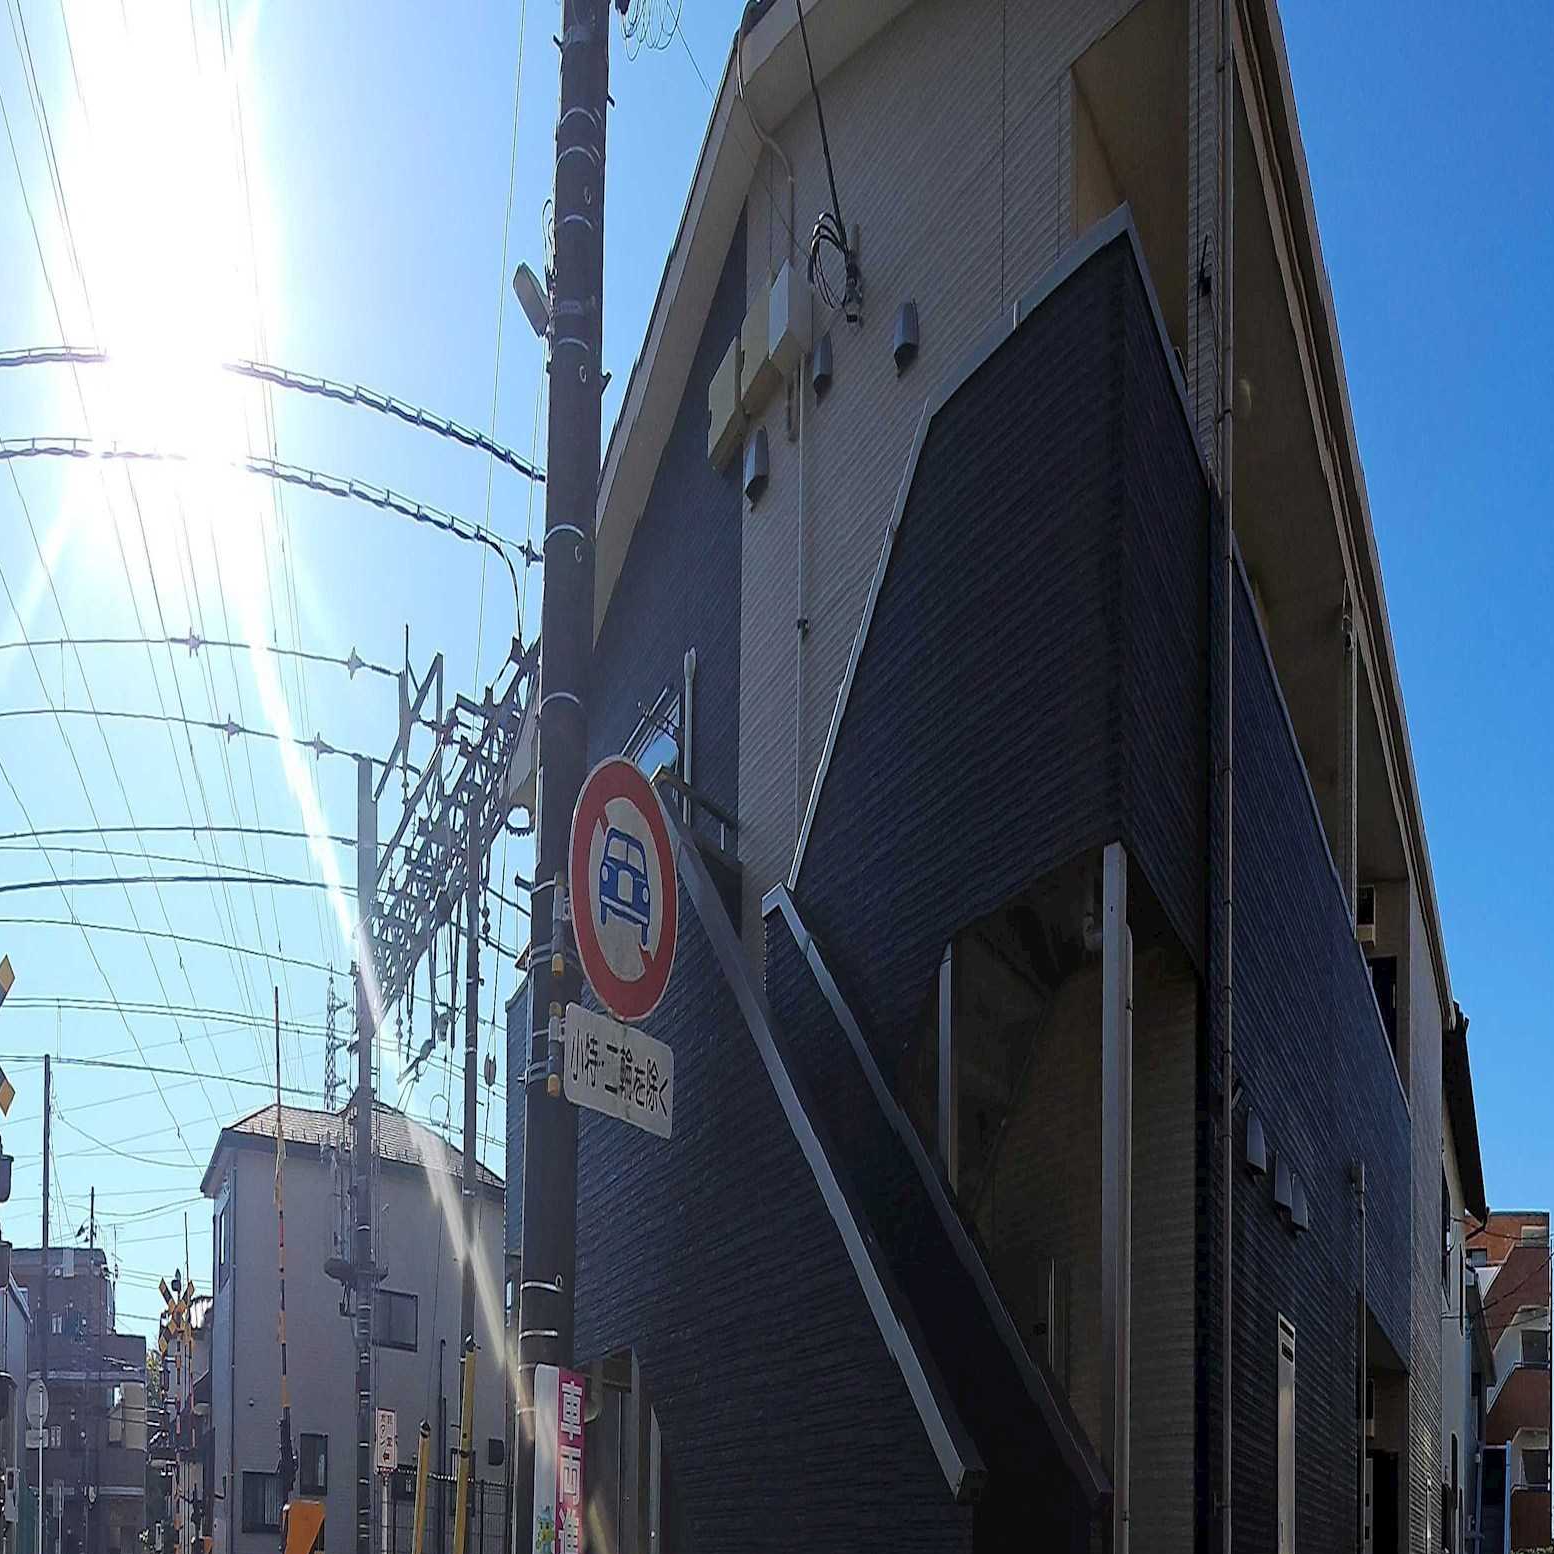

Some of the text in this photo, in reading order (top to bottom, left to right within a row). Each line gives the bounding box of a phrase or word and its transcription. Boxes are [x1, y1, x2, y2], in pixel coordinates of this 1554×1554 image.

[570, 1028, 668, 1117] 小特・二輪を除く
